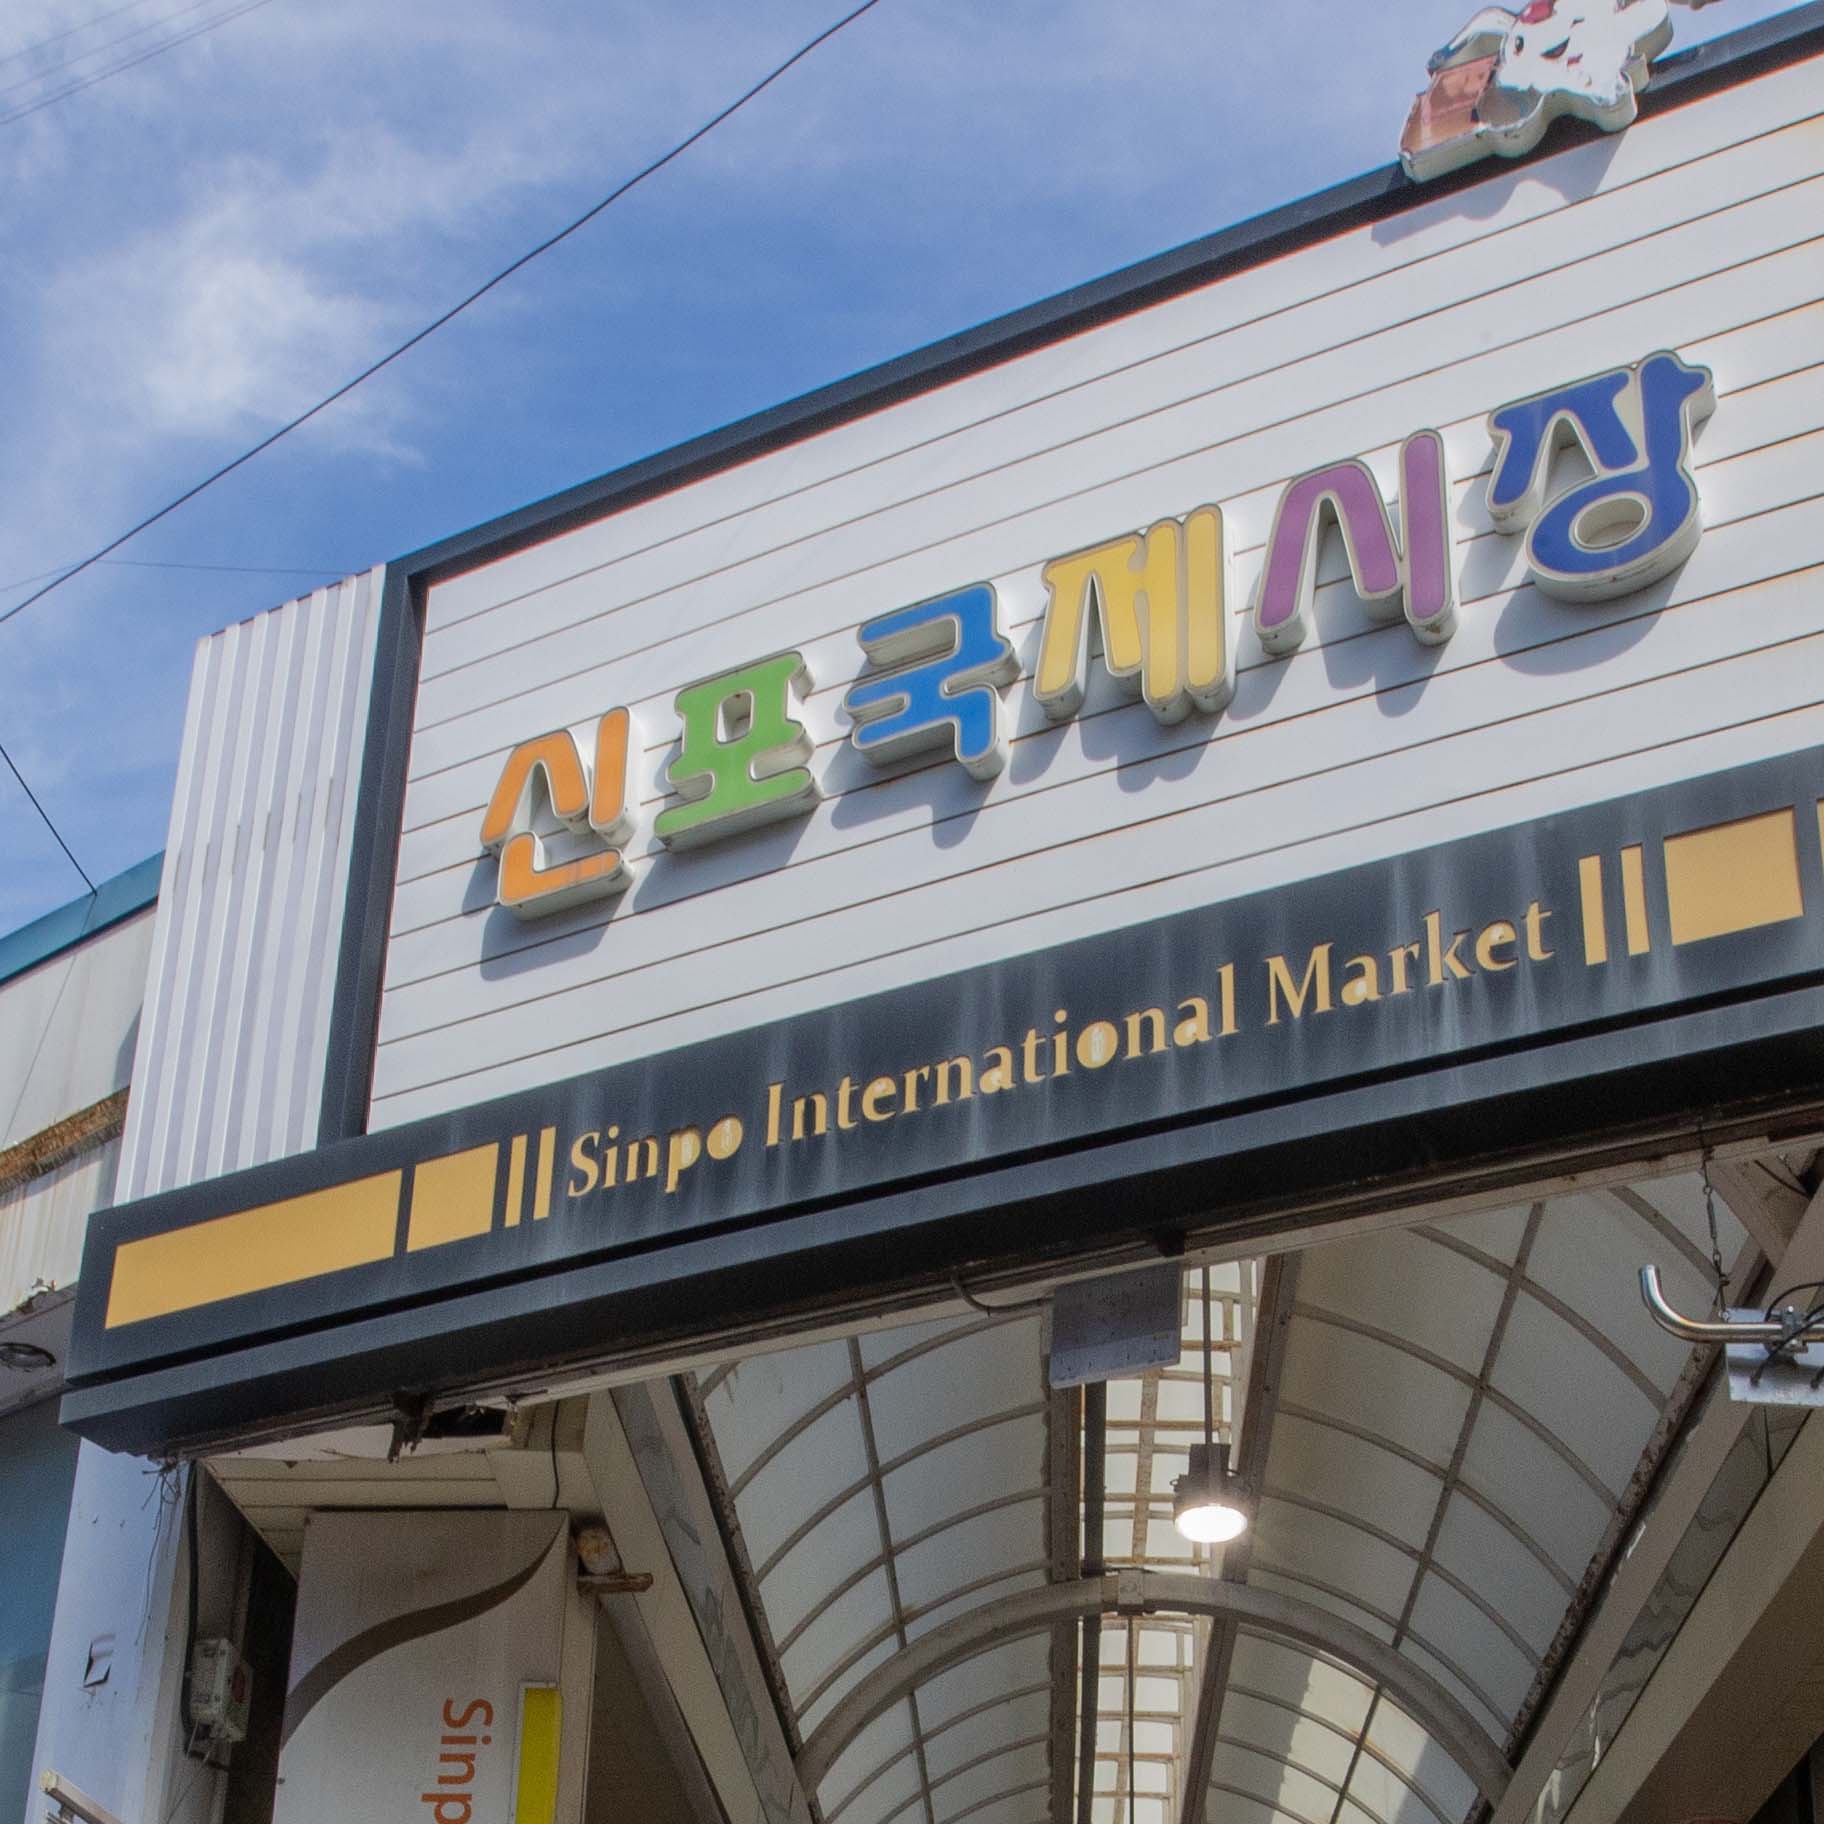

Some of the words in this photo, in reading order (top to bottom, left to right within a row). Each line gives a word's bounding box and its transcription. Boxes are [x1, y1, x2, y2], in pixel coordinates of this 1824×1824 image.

[477, 347, 1716, 920] 신포국제시장
[567, 1113, 744, 1197] Sinpo
[765, 963, 1239, 1149] International
[1264, 898, 1557, 1026] Market
